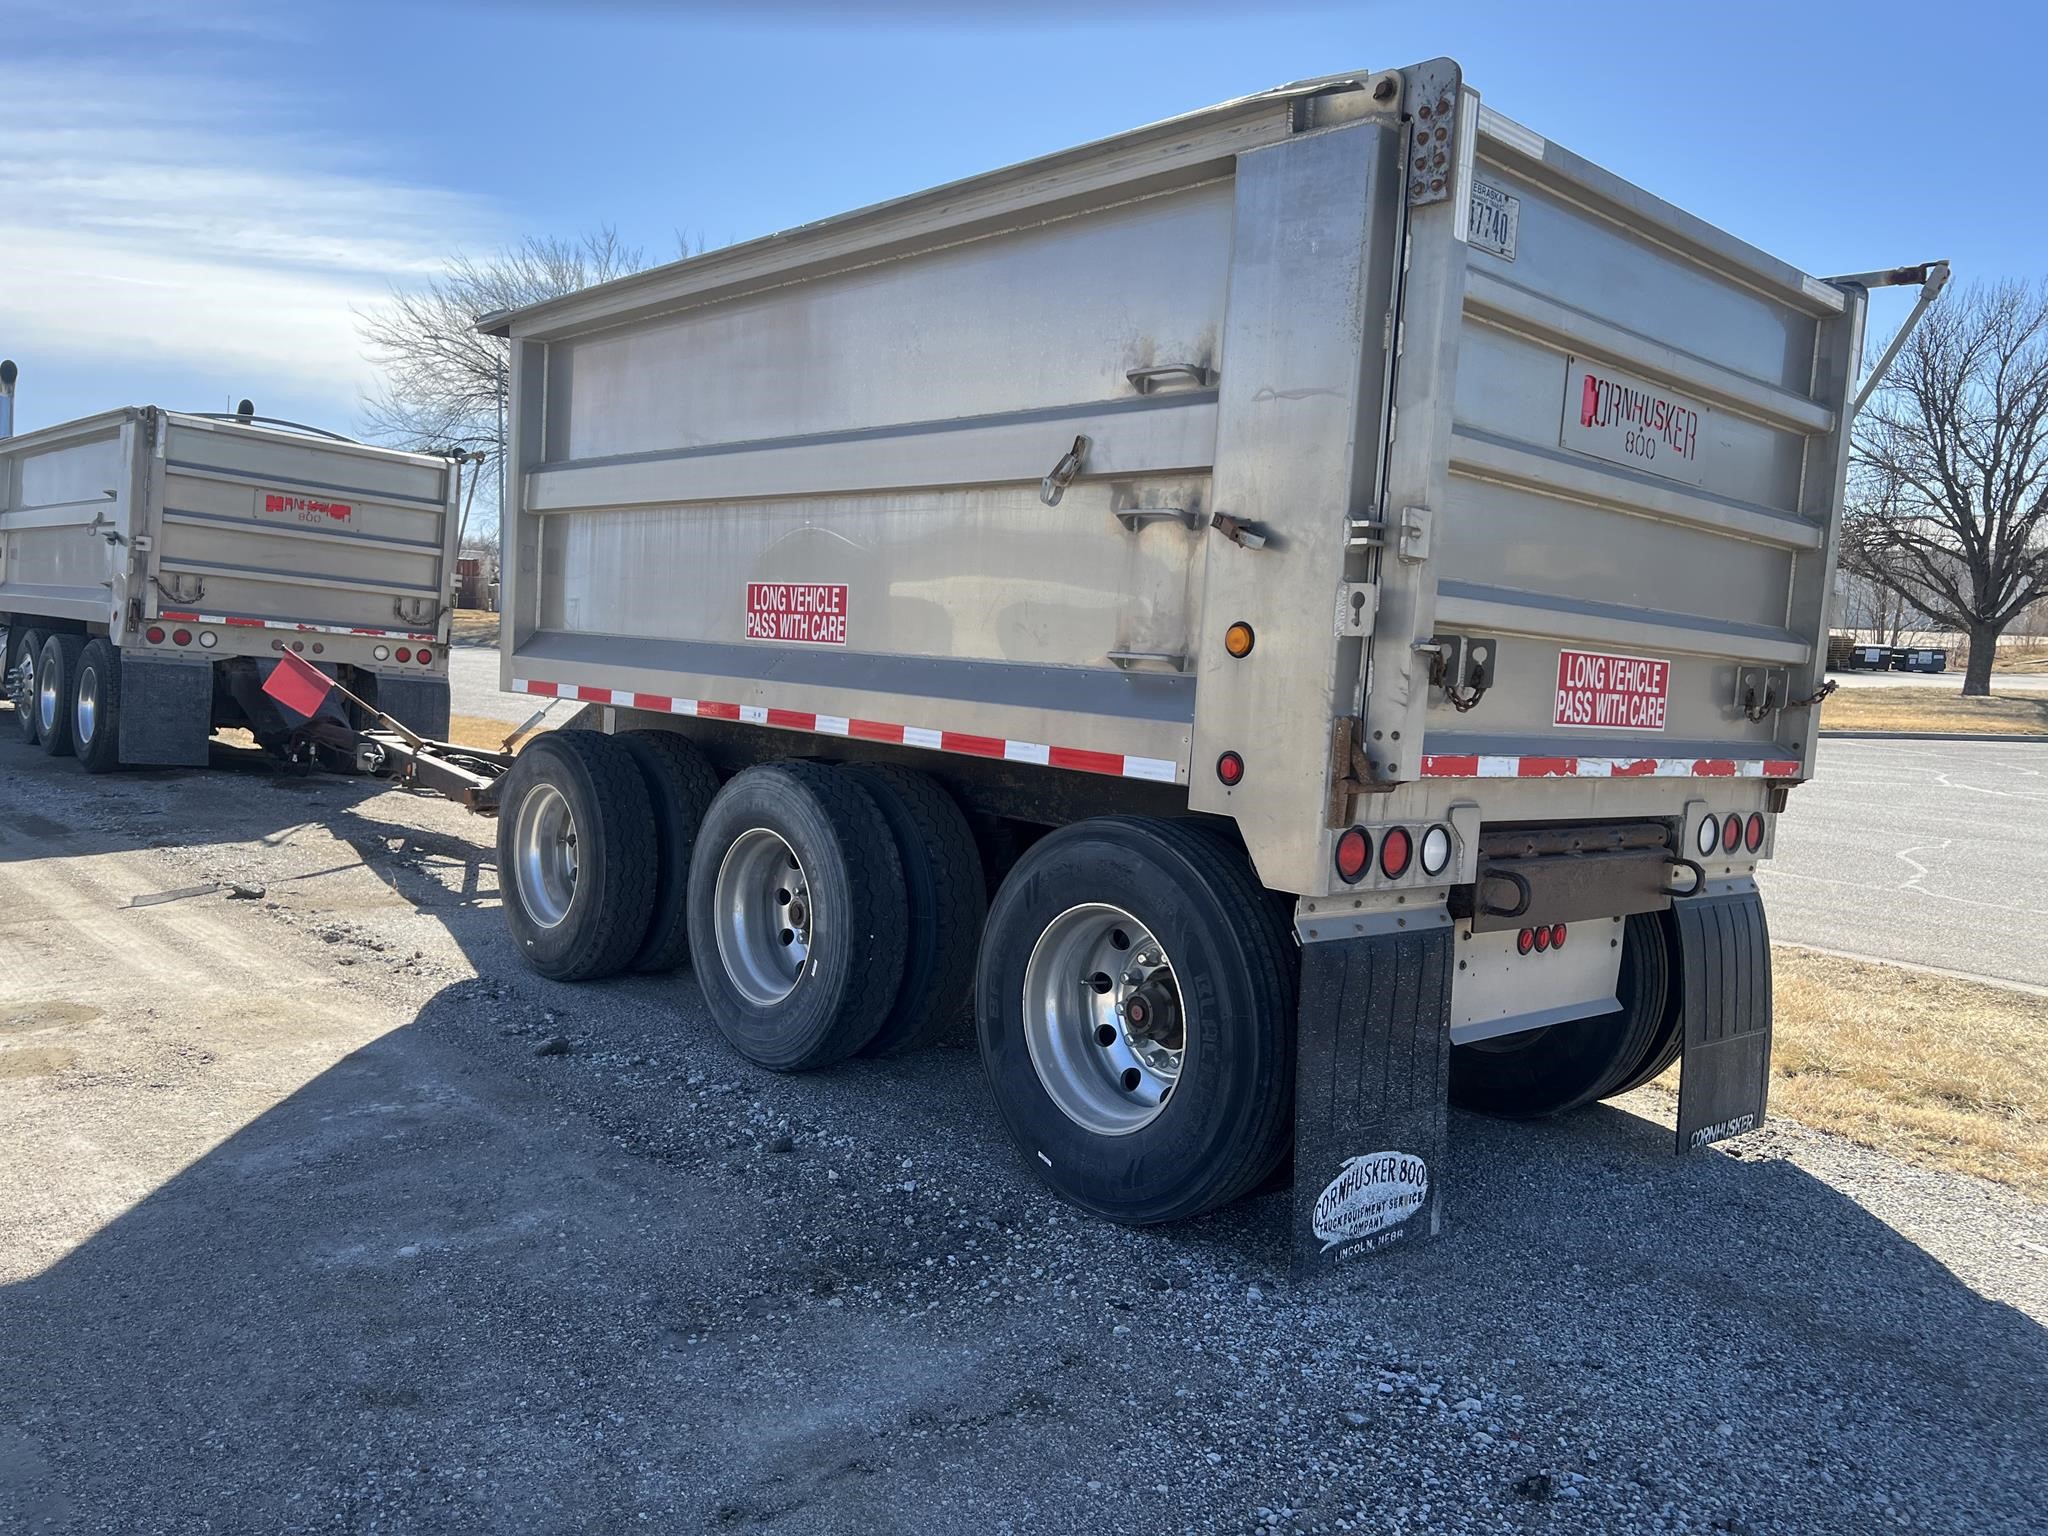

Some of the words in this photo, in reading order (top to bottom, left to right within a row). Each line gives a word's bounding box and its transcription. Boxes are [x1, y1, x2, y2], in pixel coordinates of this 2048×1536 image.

[1472, 182, 1503, 204] EBRASKA
[1625, 430, 1656, 460] 800
[753, 585, 787, 611] LONG
[789, 586, 840, 613] VEHICLE
[747, 612, 777, 638] PASS
[779, 613, 809, 640] WITH
[811, 614, 846, 642] CARE
[1566, 655, 1606, 690] LONG
[1609, 659, 1662, 694] VEHICLE
[1556, 689, 1593, 724] PASS
[1595, 692, 1628, 725] WITH
[1630, 694, 1665, 727] CARE
[1690, 1113, 1754, 1149] CORNHUSKER
[1314, 1157, 1397, 1228] CORNHUSKER
[1399, 1159, 1425, 1187] 800
[1387, 1191, 1424, 1210] SERICE
[1348, 1215, 1385, 1236] COMPANY
